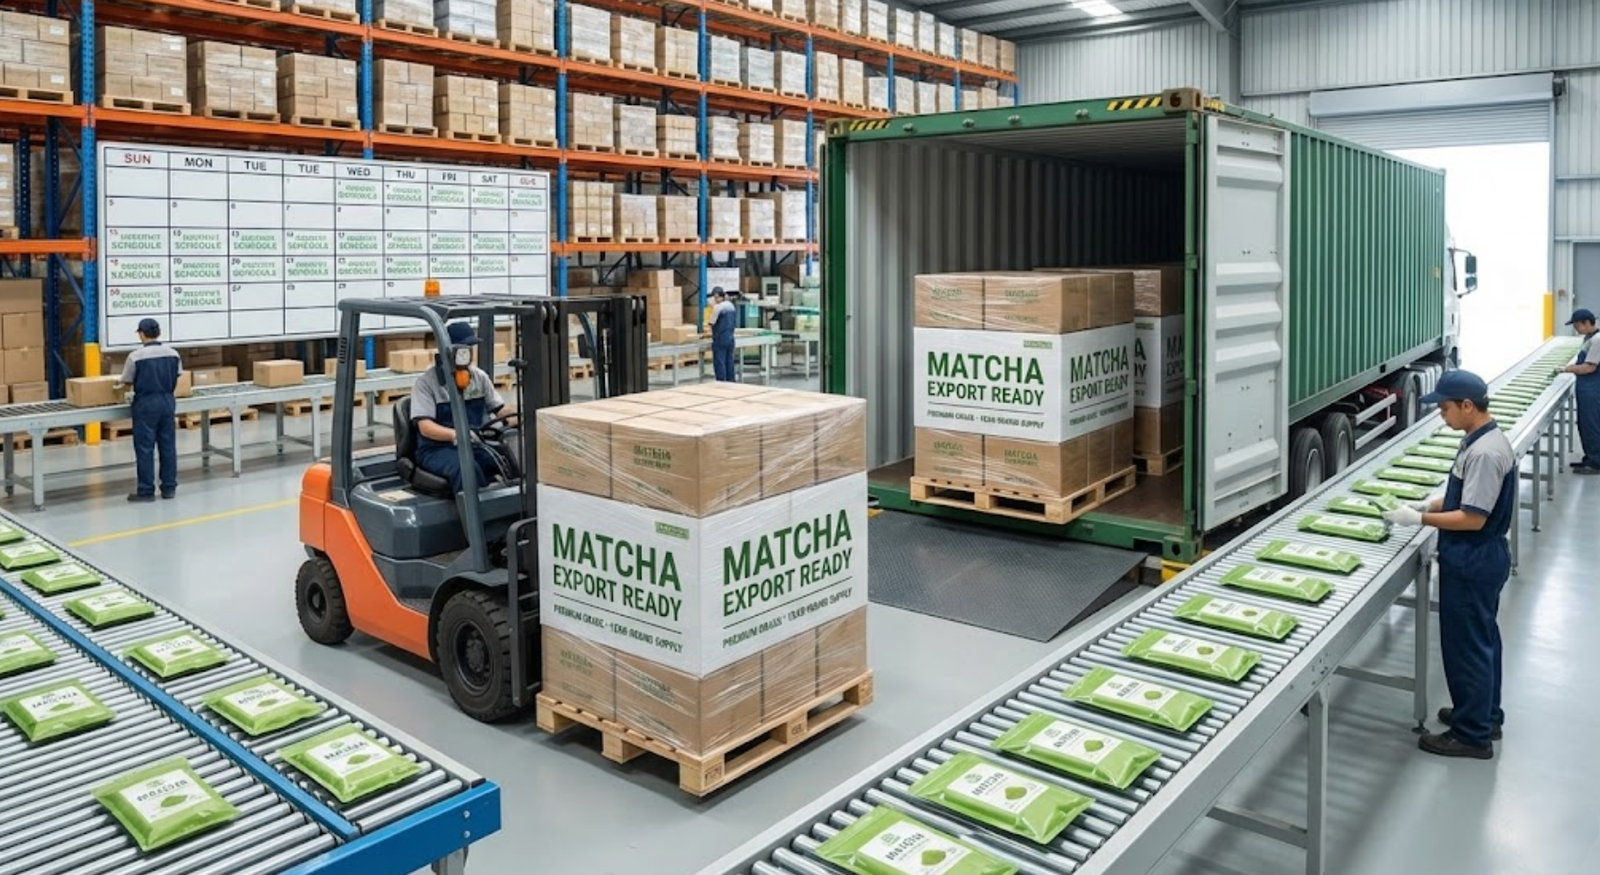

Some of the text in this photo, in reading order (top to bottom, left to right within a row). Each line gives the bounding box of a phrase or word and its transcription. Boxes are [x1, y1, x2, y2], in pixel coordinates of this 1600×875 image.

[124, 153, 151, 164] SUN
[185, 157, 213, 168] MON
[244, 161, 267, 171] TUE
[298, 164, 320, 174] TUE
[347, 167, 371, 177] WED
[396, 170, 416, 179] THU
[482, 175, 497, 184] SAT
[927, 351, 1045, 386] MATCHA
[1071, 345, 1129, 383] MATCHA
[927, 381, 1045, 407] EXPORT READY
[723, 509, 852, 586] MATCHA
[553, 523, 682, 592] MATCHA
[724, 547, 853, 617] EXPORT READY
[553, 564, 682, 621] EXPORT READY
